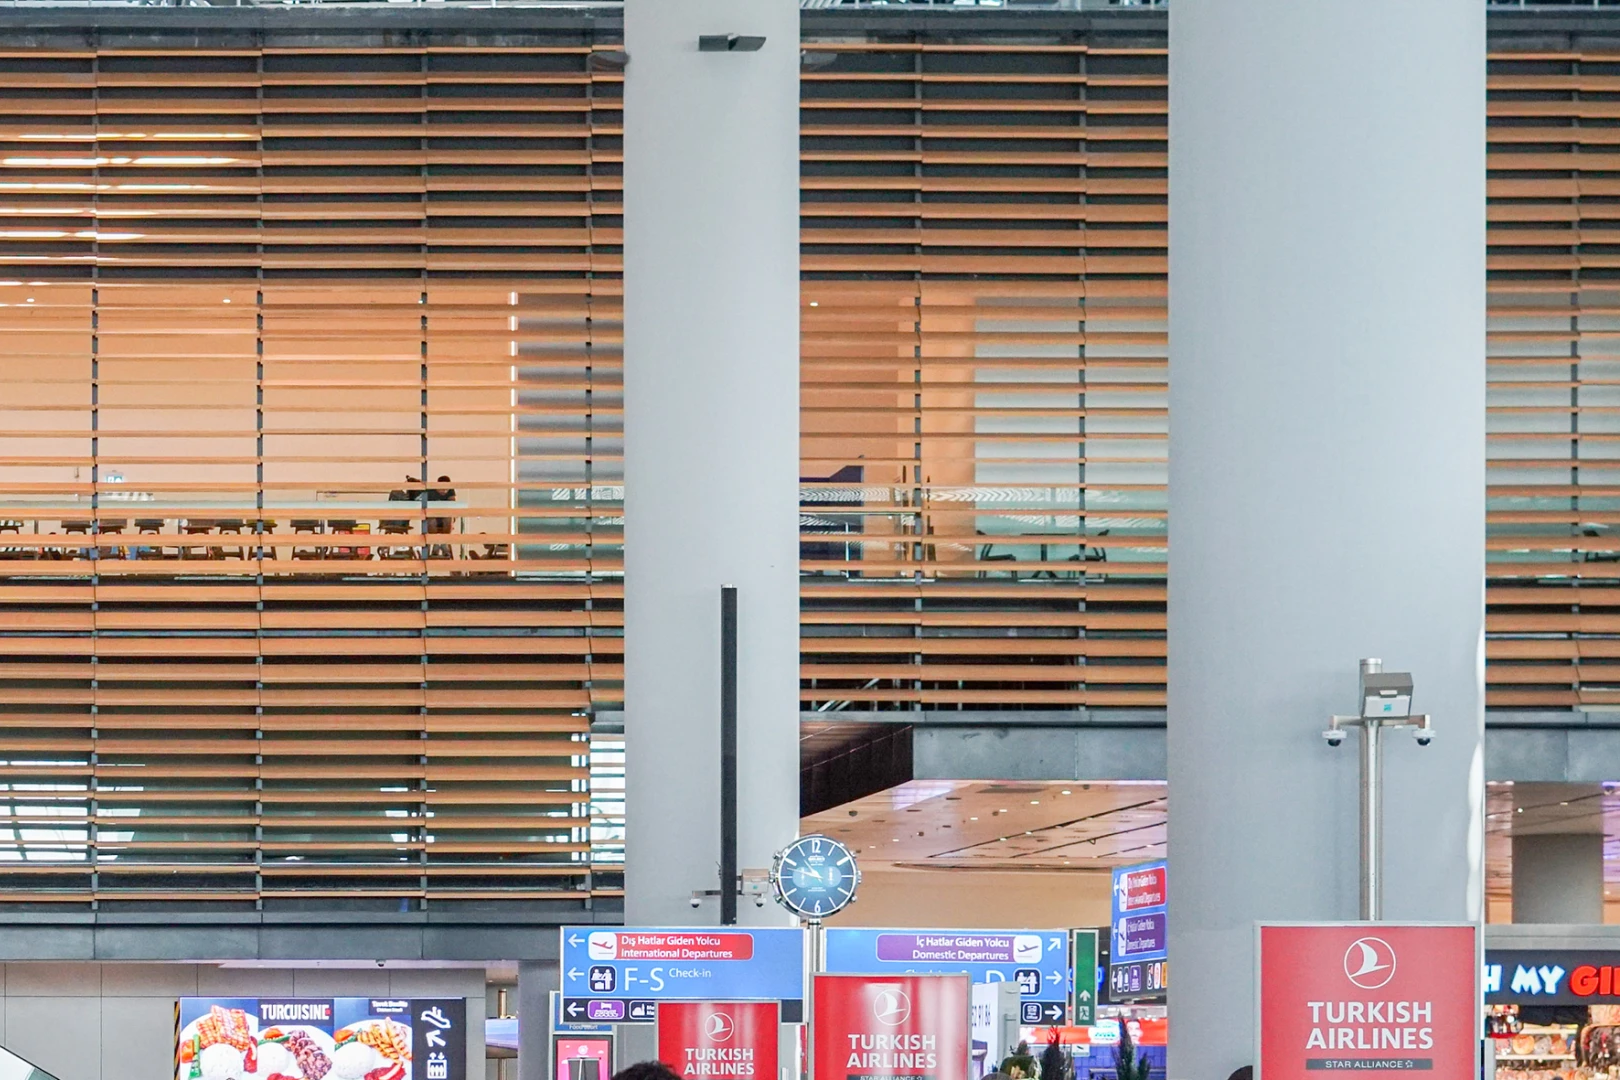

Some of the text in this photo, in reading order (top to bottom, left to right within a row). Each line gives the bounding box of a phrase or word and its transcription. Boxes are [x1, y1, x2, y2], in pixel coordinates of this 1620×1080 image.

[812, 839, 821, 854] 12
[814, 900, 821, 913] 6
[621, 935, 721, 946] Dış Hatlar Giden Yolcu
[916, 935, 1009, 948] İç Hatlar Giden Yolcu
[621, 948, 733, 960] International Departures
[912, 950, 1009, 962] Domestic Departures
[624, 967, 712, 992] F-S Check-in
[1511, 964, 1565, 995] MY
[261, 1004, 330, 1021] TURCUISINE
[1307, 1001, 1432, 1023] TURKISH
[848, 1034, 936, 1050] TURKISH
[1306, 1028, 1433, 1050] AIRLINES
[684, 1048, 754, 1061] TURKISH
[846, 1052, 937, 1069] AIRLINES
[683, 1062, 755, 1075] AIRLINES
[1325, 1060, 1403, 1069] STAR ALLIANCE
